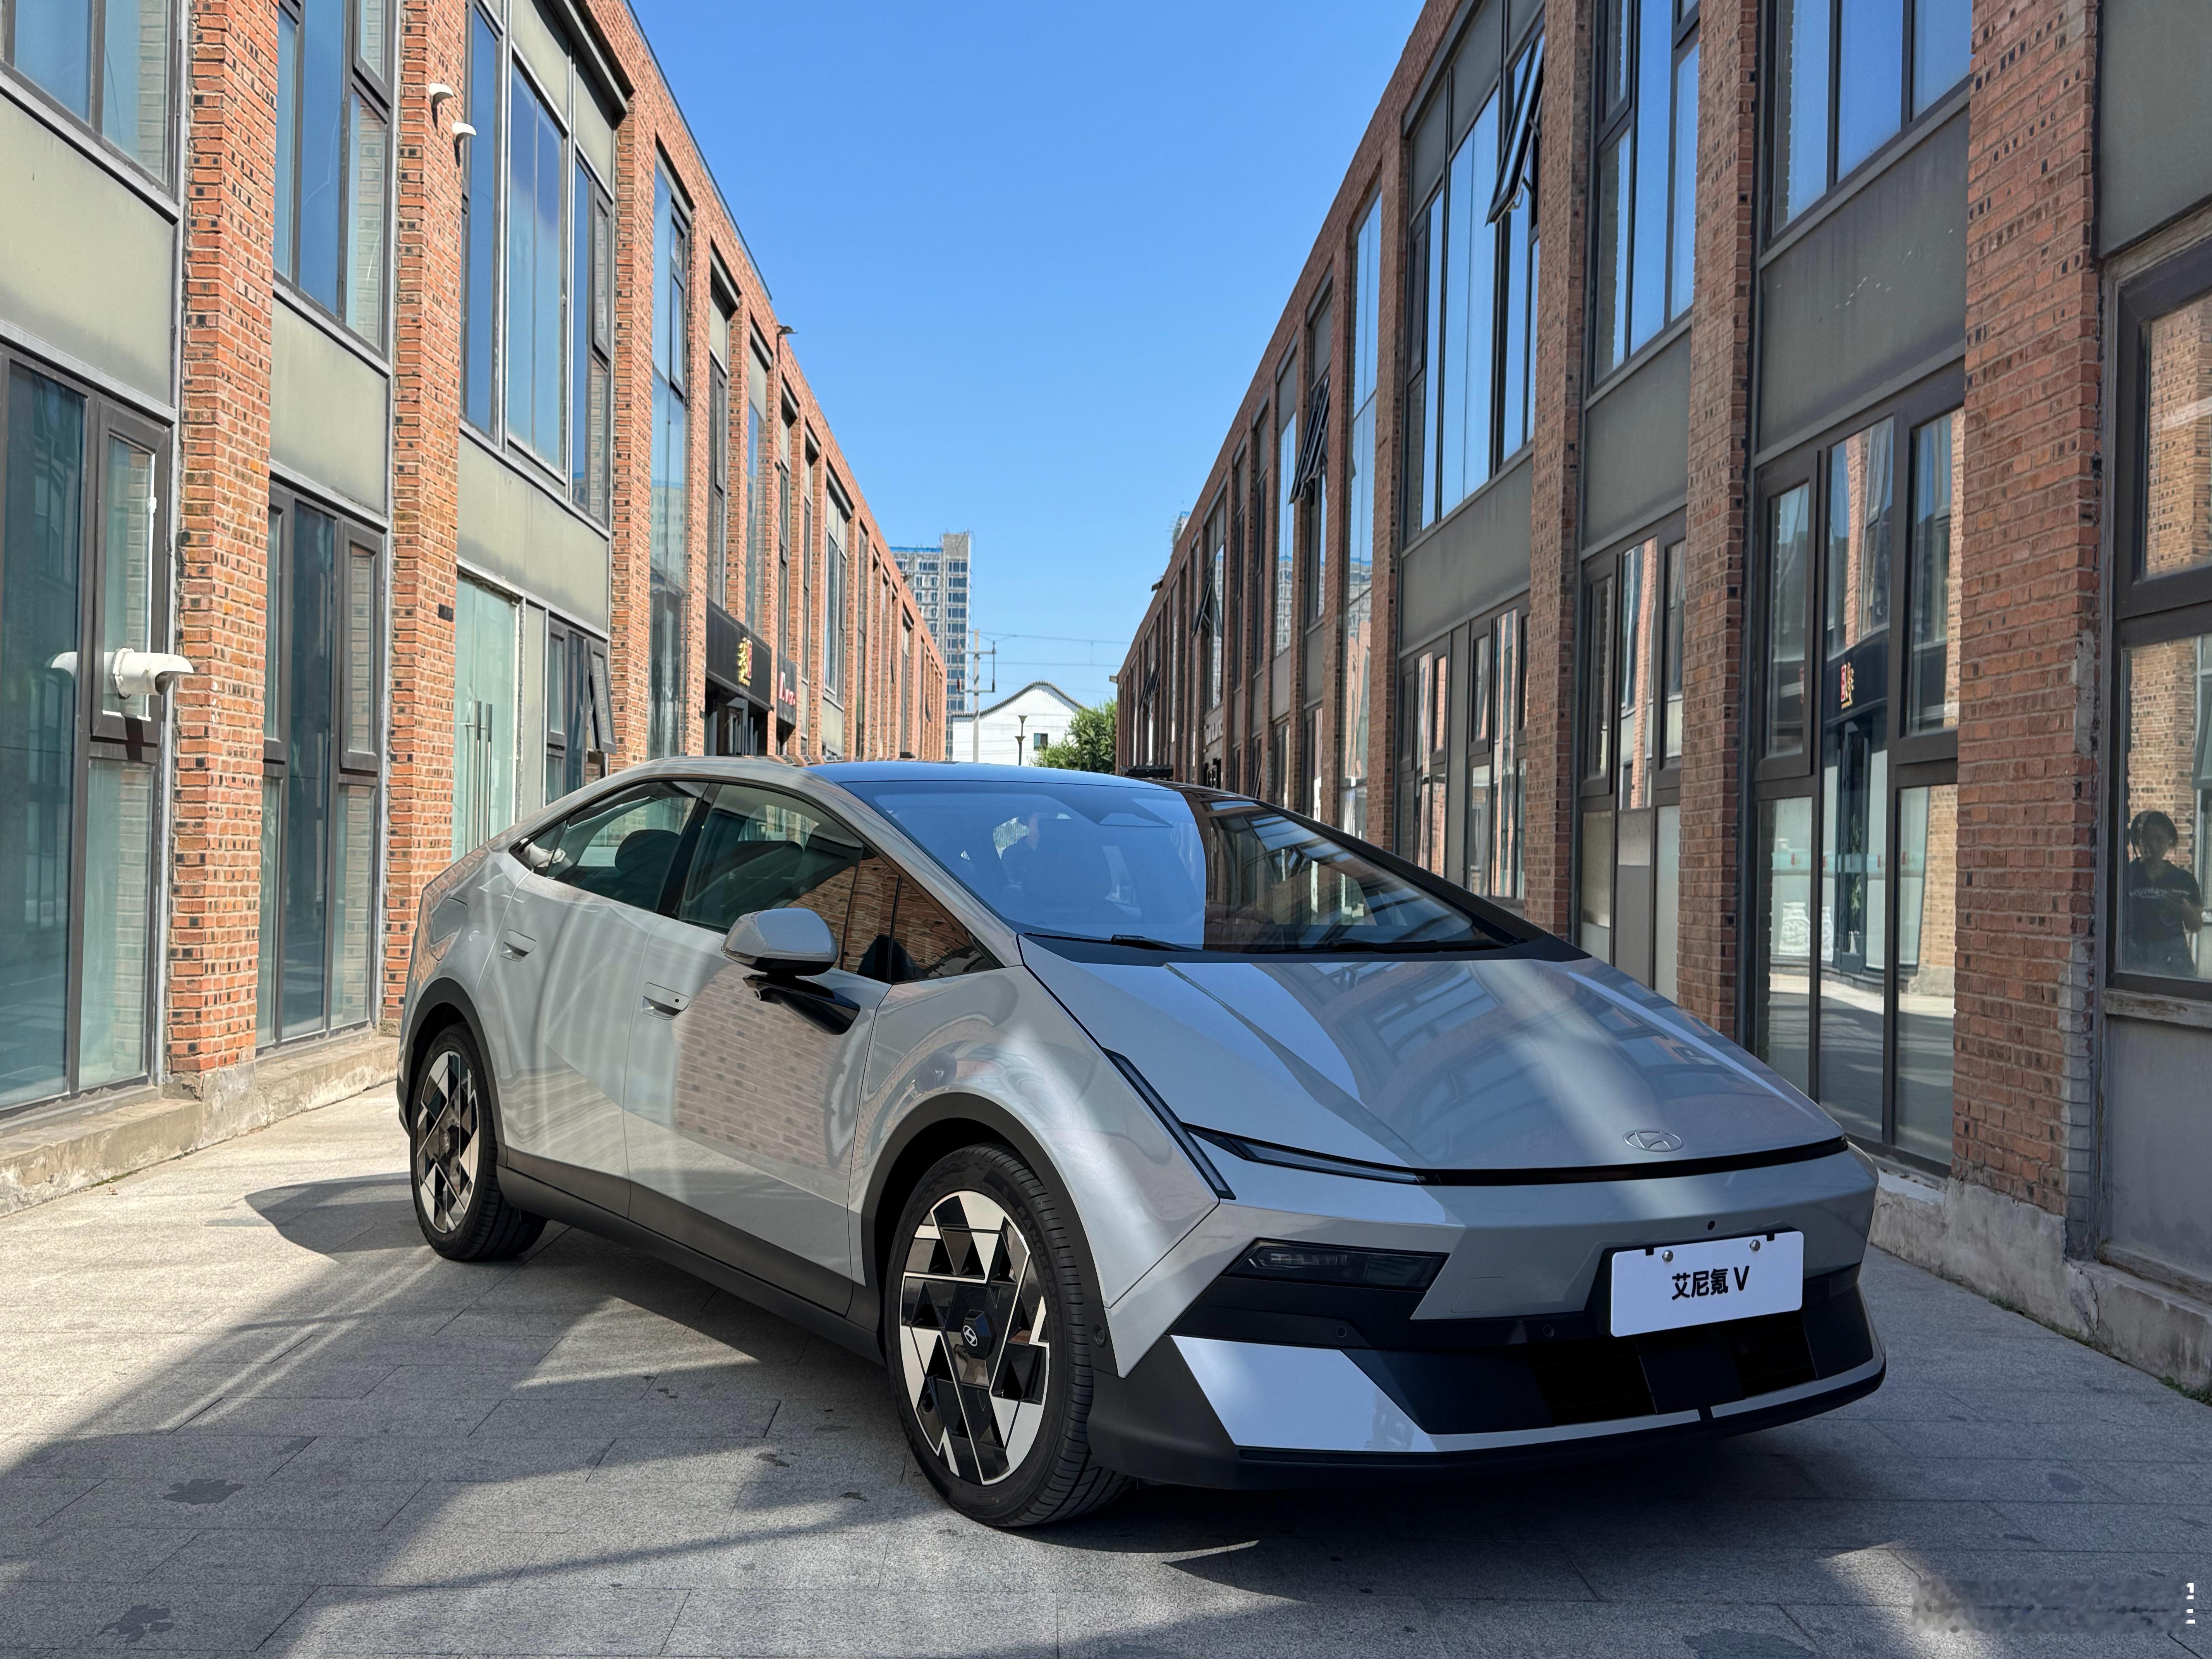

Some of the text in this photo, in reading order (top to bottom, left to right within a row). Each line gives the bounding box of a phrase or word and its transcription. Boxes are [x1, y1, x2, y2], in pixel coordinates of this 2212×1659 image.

[1671, 1266, 1750, 1300] 艾尼氪 V
